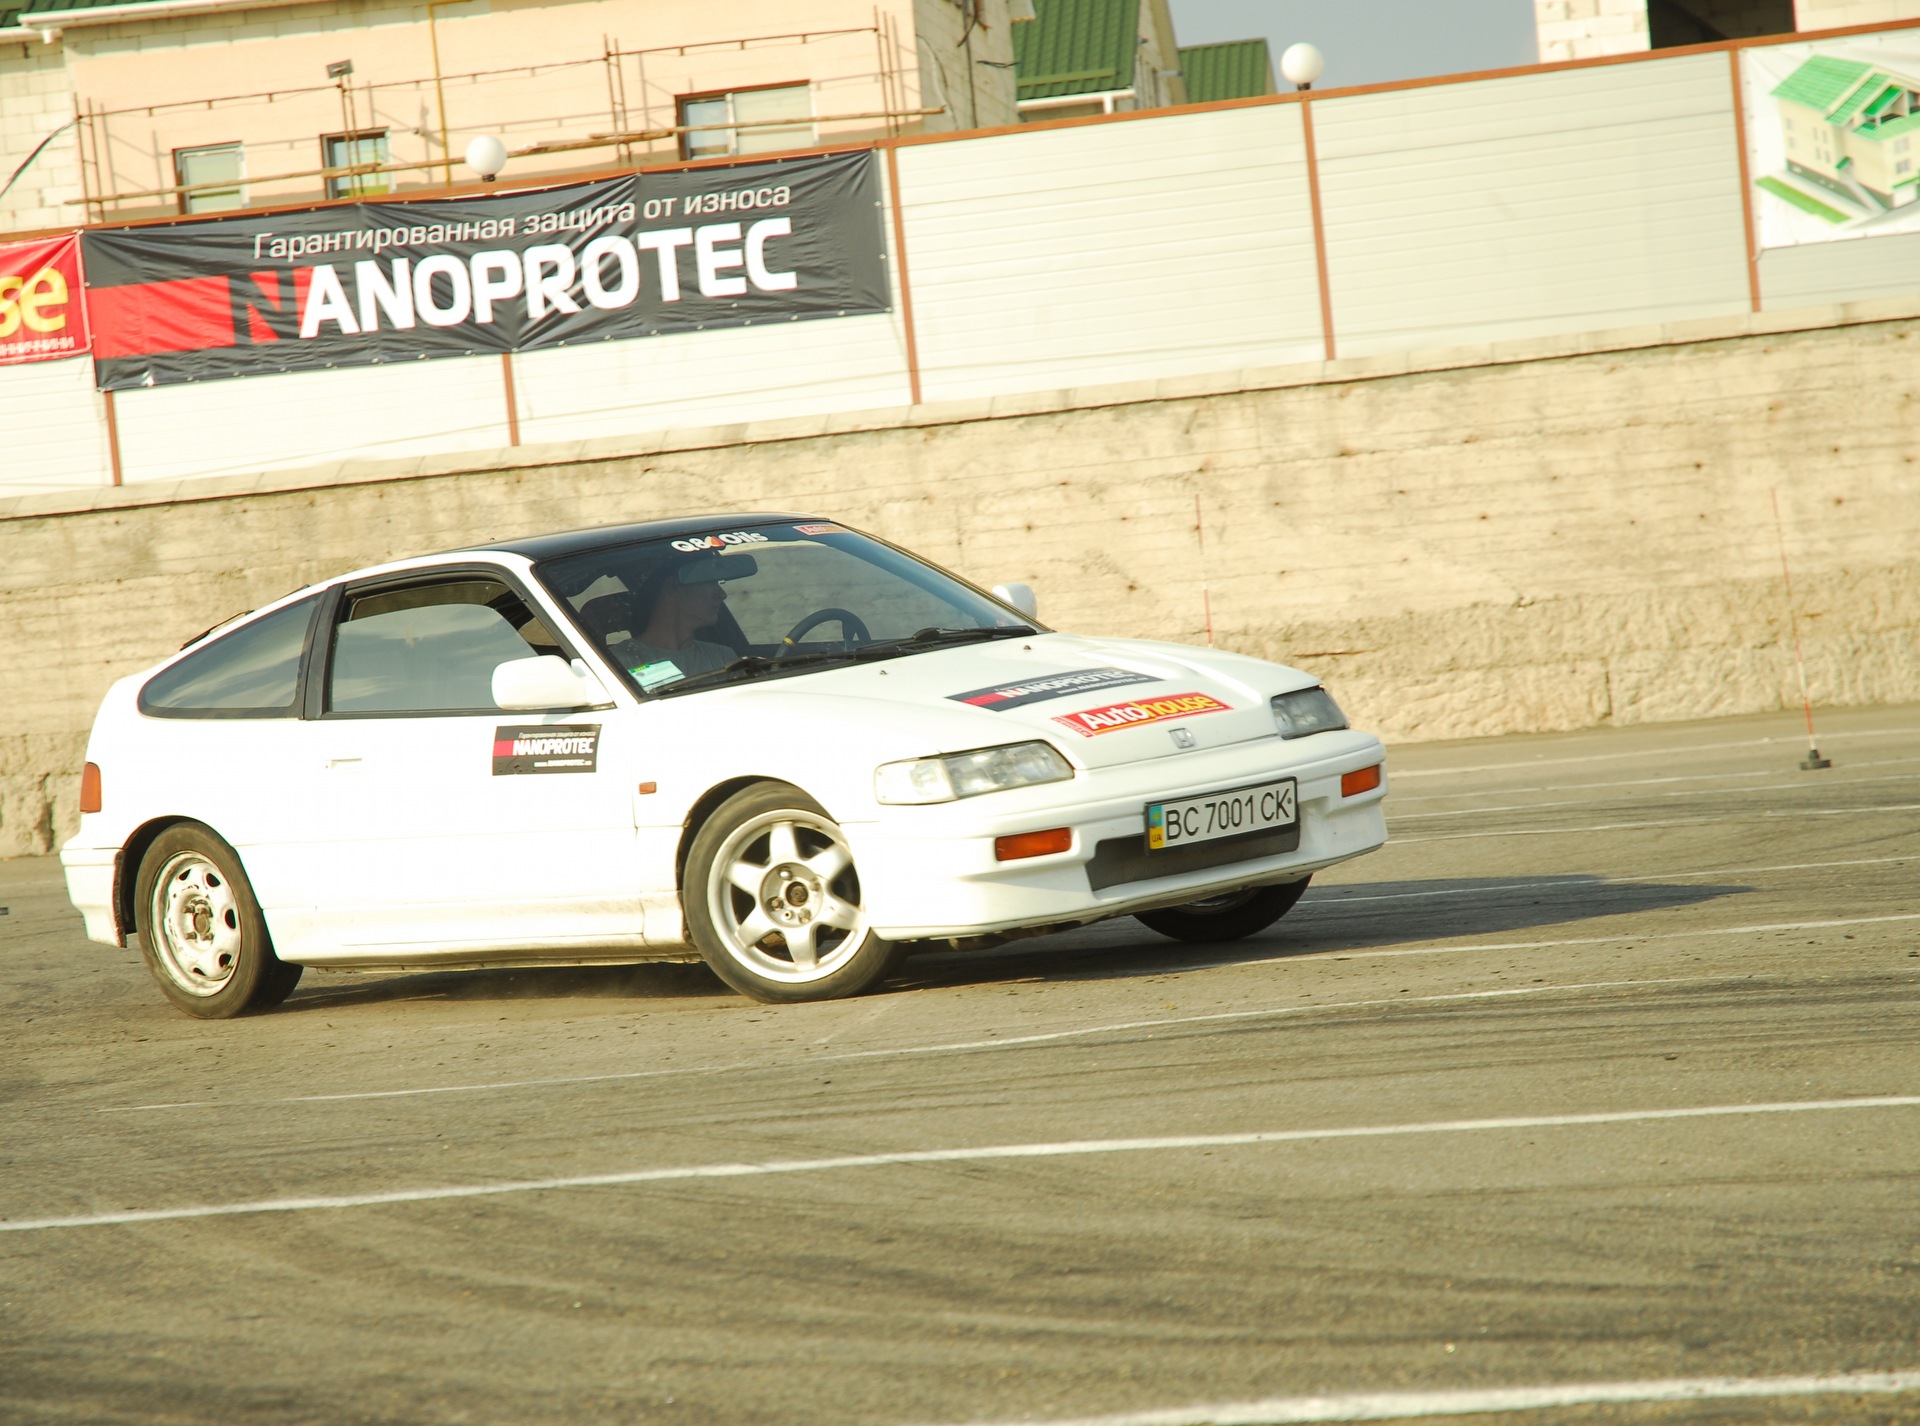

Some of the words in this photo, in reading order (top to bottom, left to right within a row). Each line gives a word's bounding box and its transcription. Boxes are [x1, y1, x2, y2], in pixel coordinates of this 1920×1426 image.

[253, 217, 515, 262] Гарантированная
[523, 203, 635, 236] защита
[643, 196, 678, 220] от
[683, 185, 791, 215] износа
[718, 532, 768, 545] Oils
[994, 669, 1136, 698] NANOPROTEC
[1080, 694, 1219, 730] Autohouse
[513, 738, 595, 755] NANOPROTEC
[1166, 807, 1199, 840] BC
[1204, 795, 1254, 833] 7001
[1261, 788, 1290, 821] CK
[1151, 833, 1162, 842] UA
